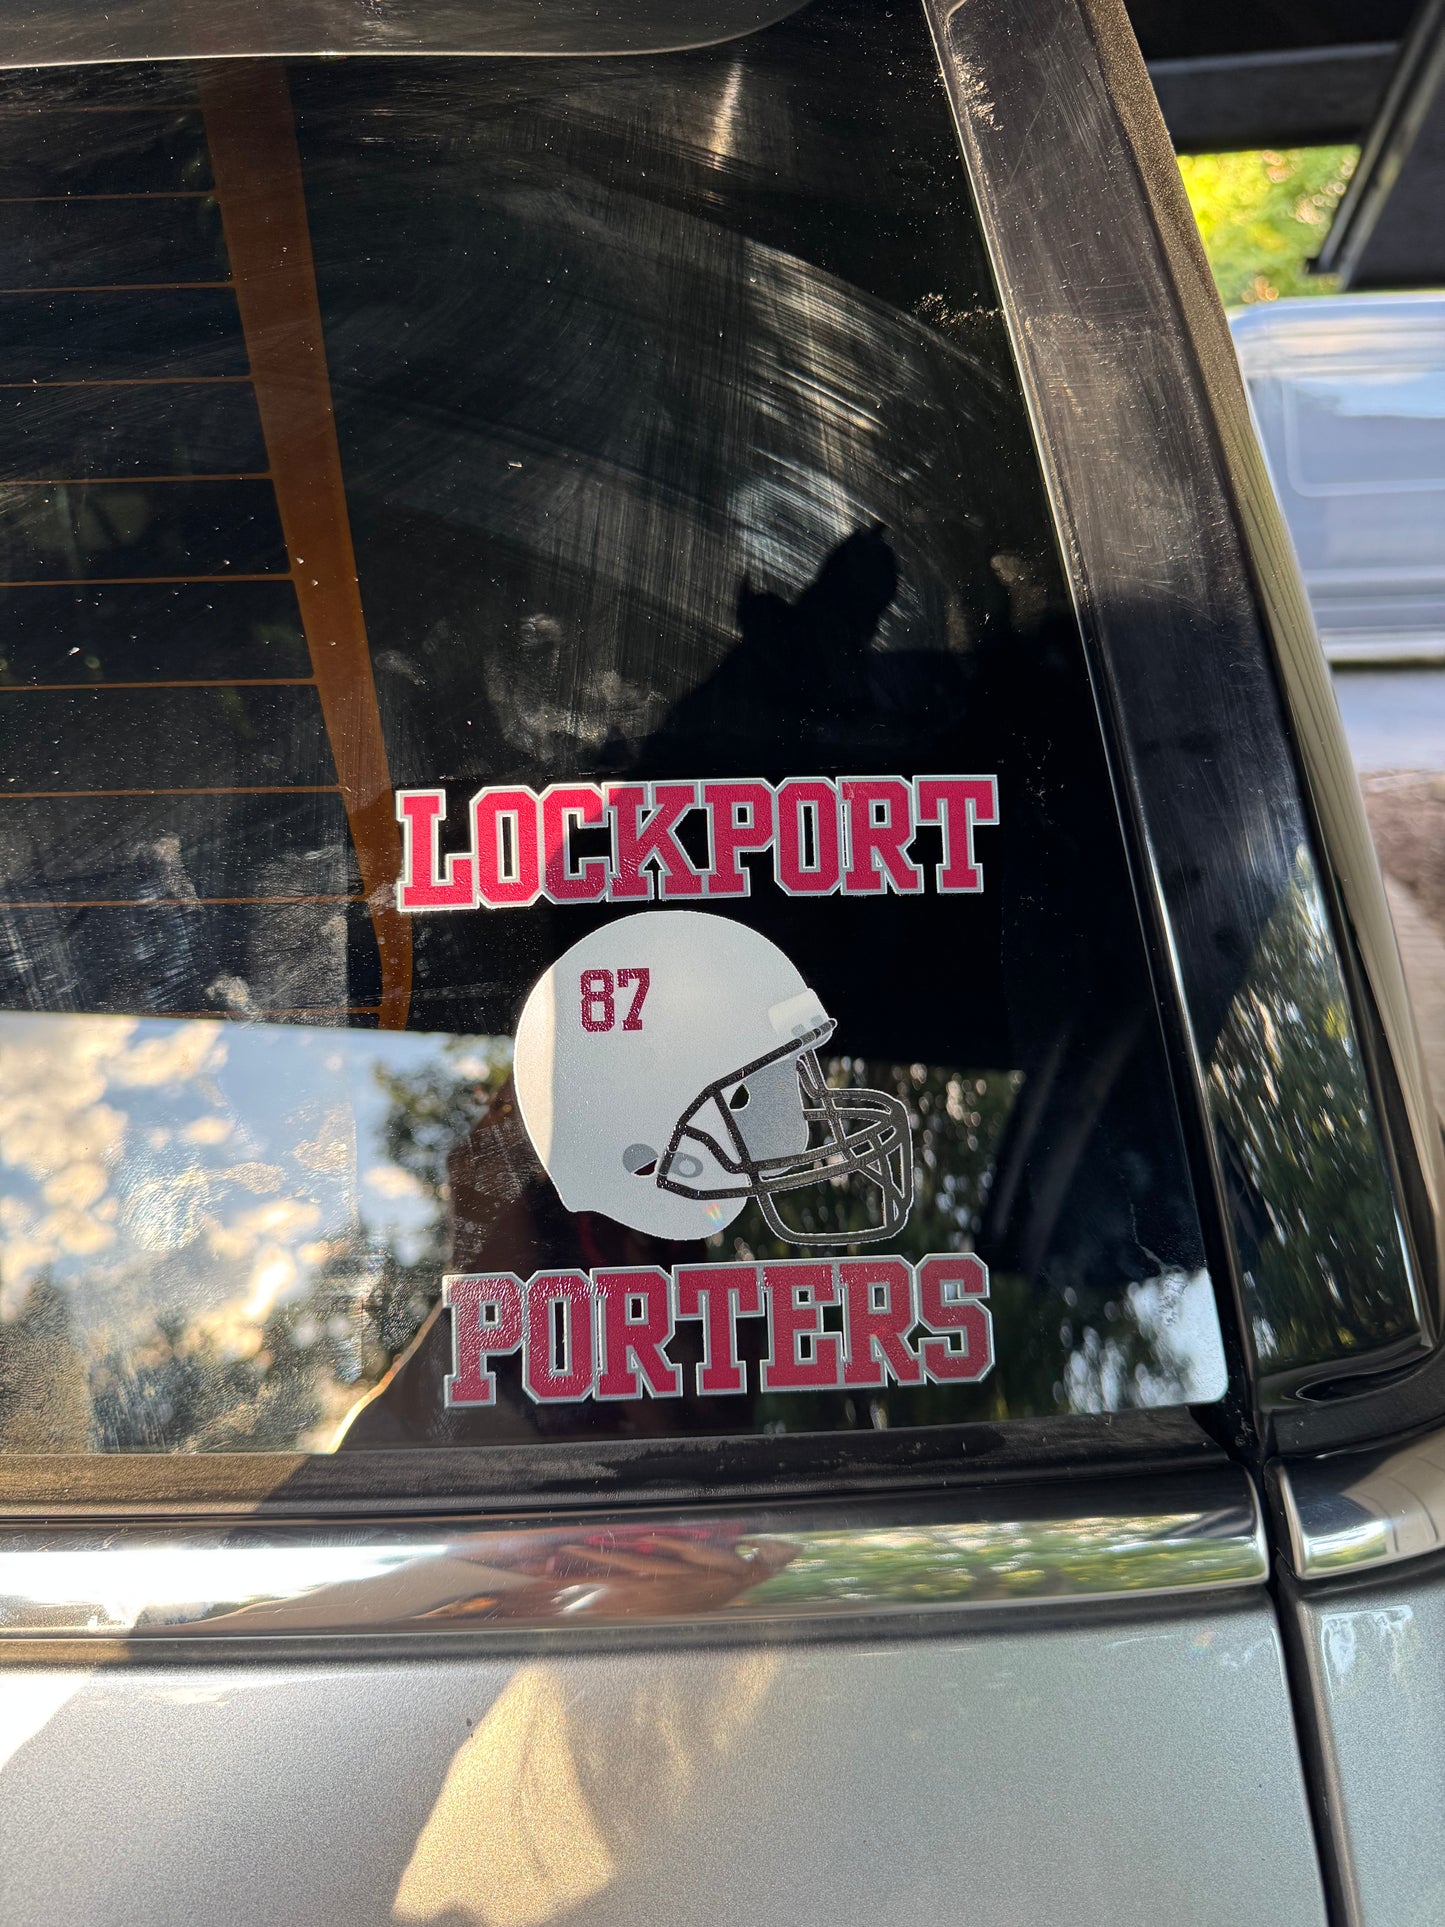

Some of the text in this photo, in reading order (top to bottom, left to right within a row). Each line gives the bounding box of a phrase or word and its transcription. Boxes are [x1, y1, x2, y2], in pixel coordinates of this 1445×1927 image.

[396, 774, 1000, 913] LOCKPORT
[579, 967, 651, 1033] 87
[442, 1253, 995, 1408] PORTERS
